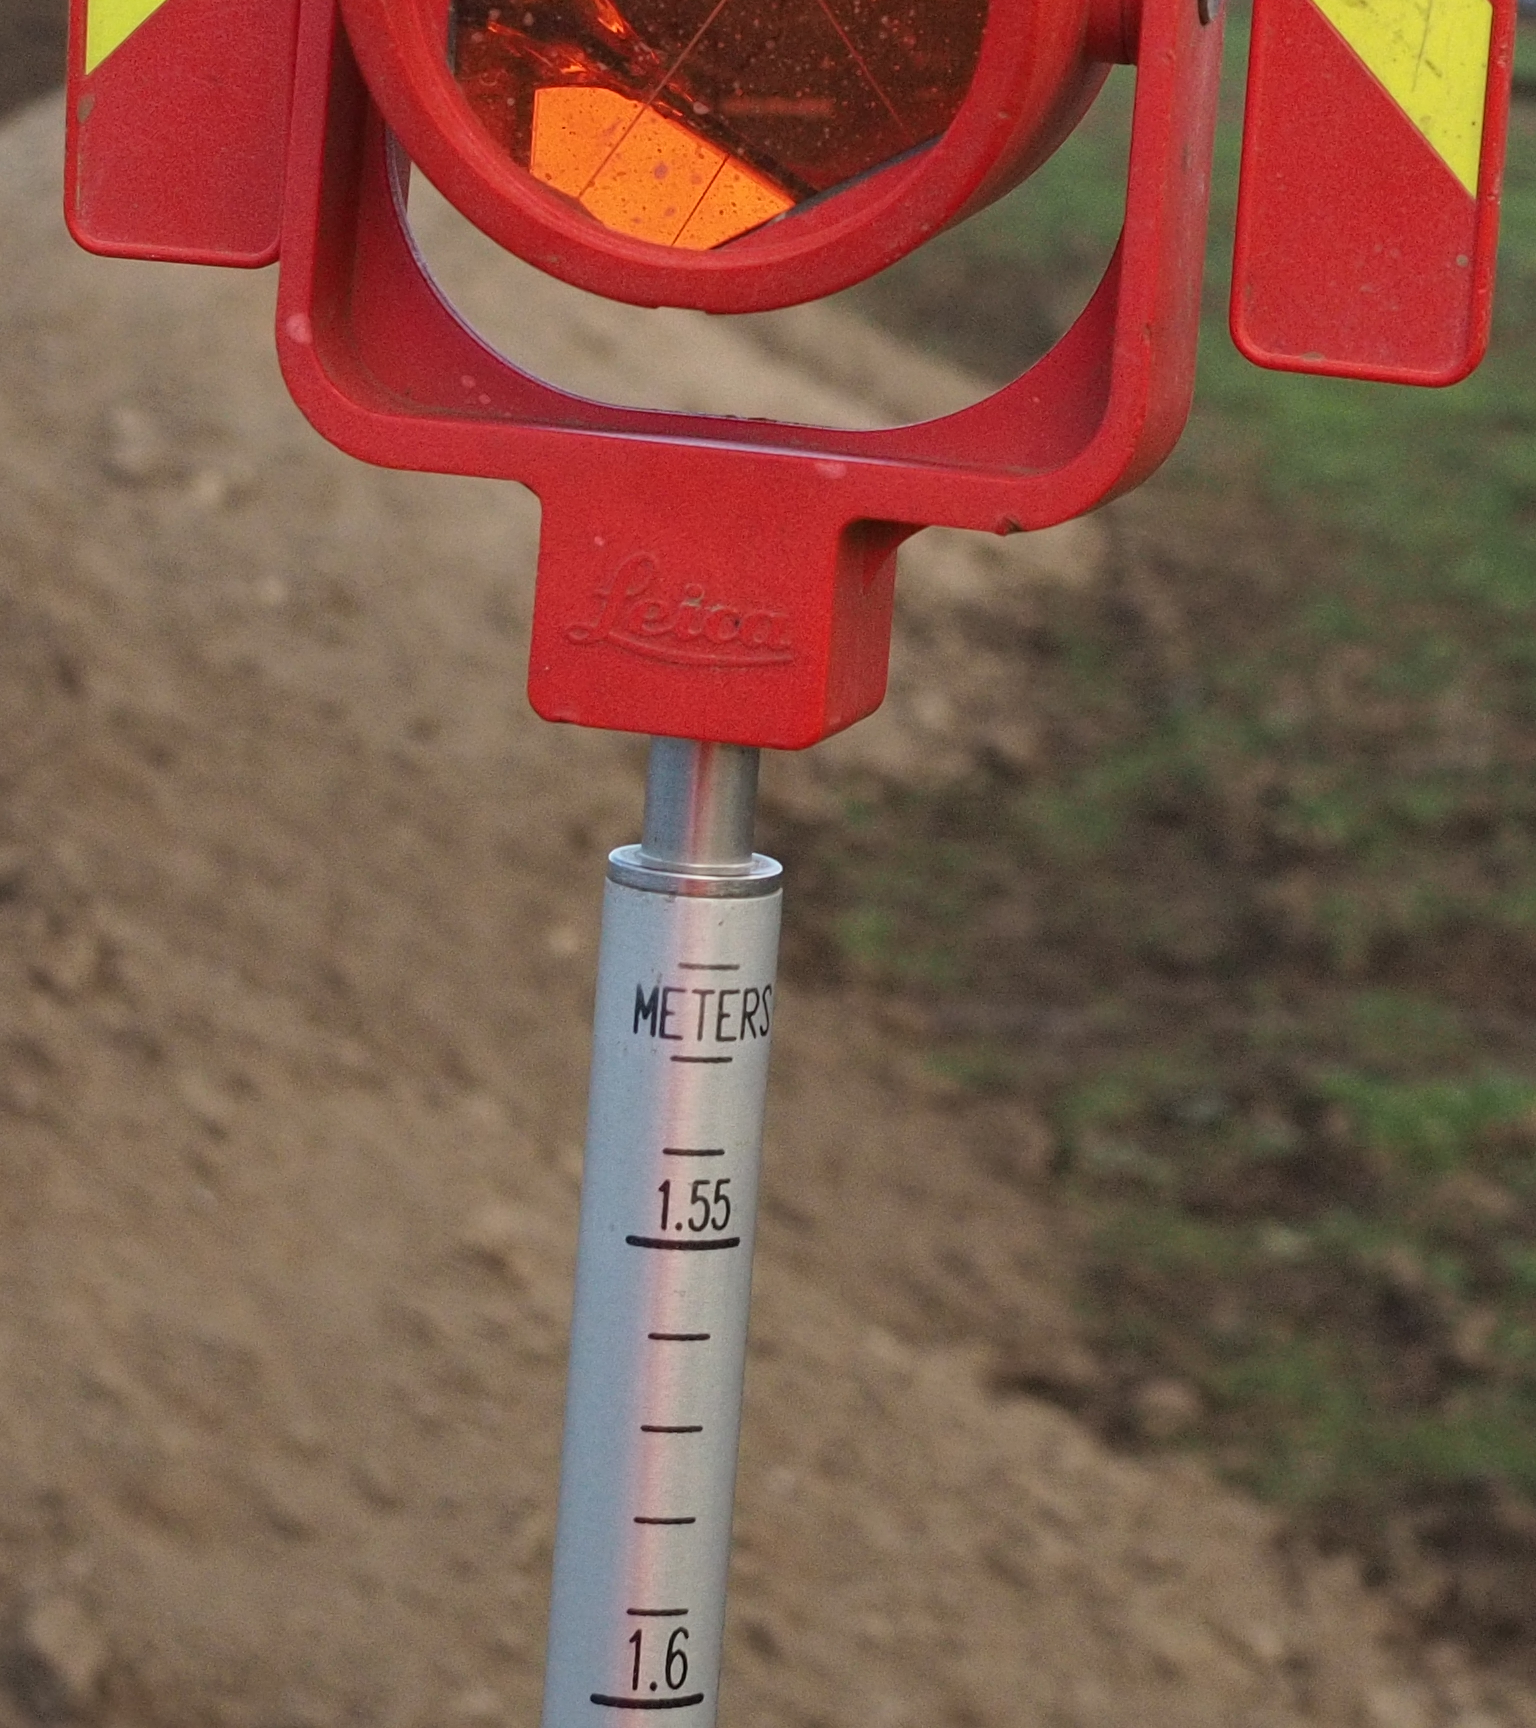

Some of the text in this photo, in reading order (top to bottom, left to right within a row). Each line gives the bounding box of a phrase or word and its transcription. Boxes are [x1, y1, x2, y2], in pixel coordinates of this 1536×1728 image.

[632, 982, 772, 1043] METERS
[658, 1177, 732, 1233] 1.55
[628, 1625, 690, 1692] 1.6
